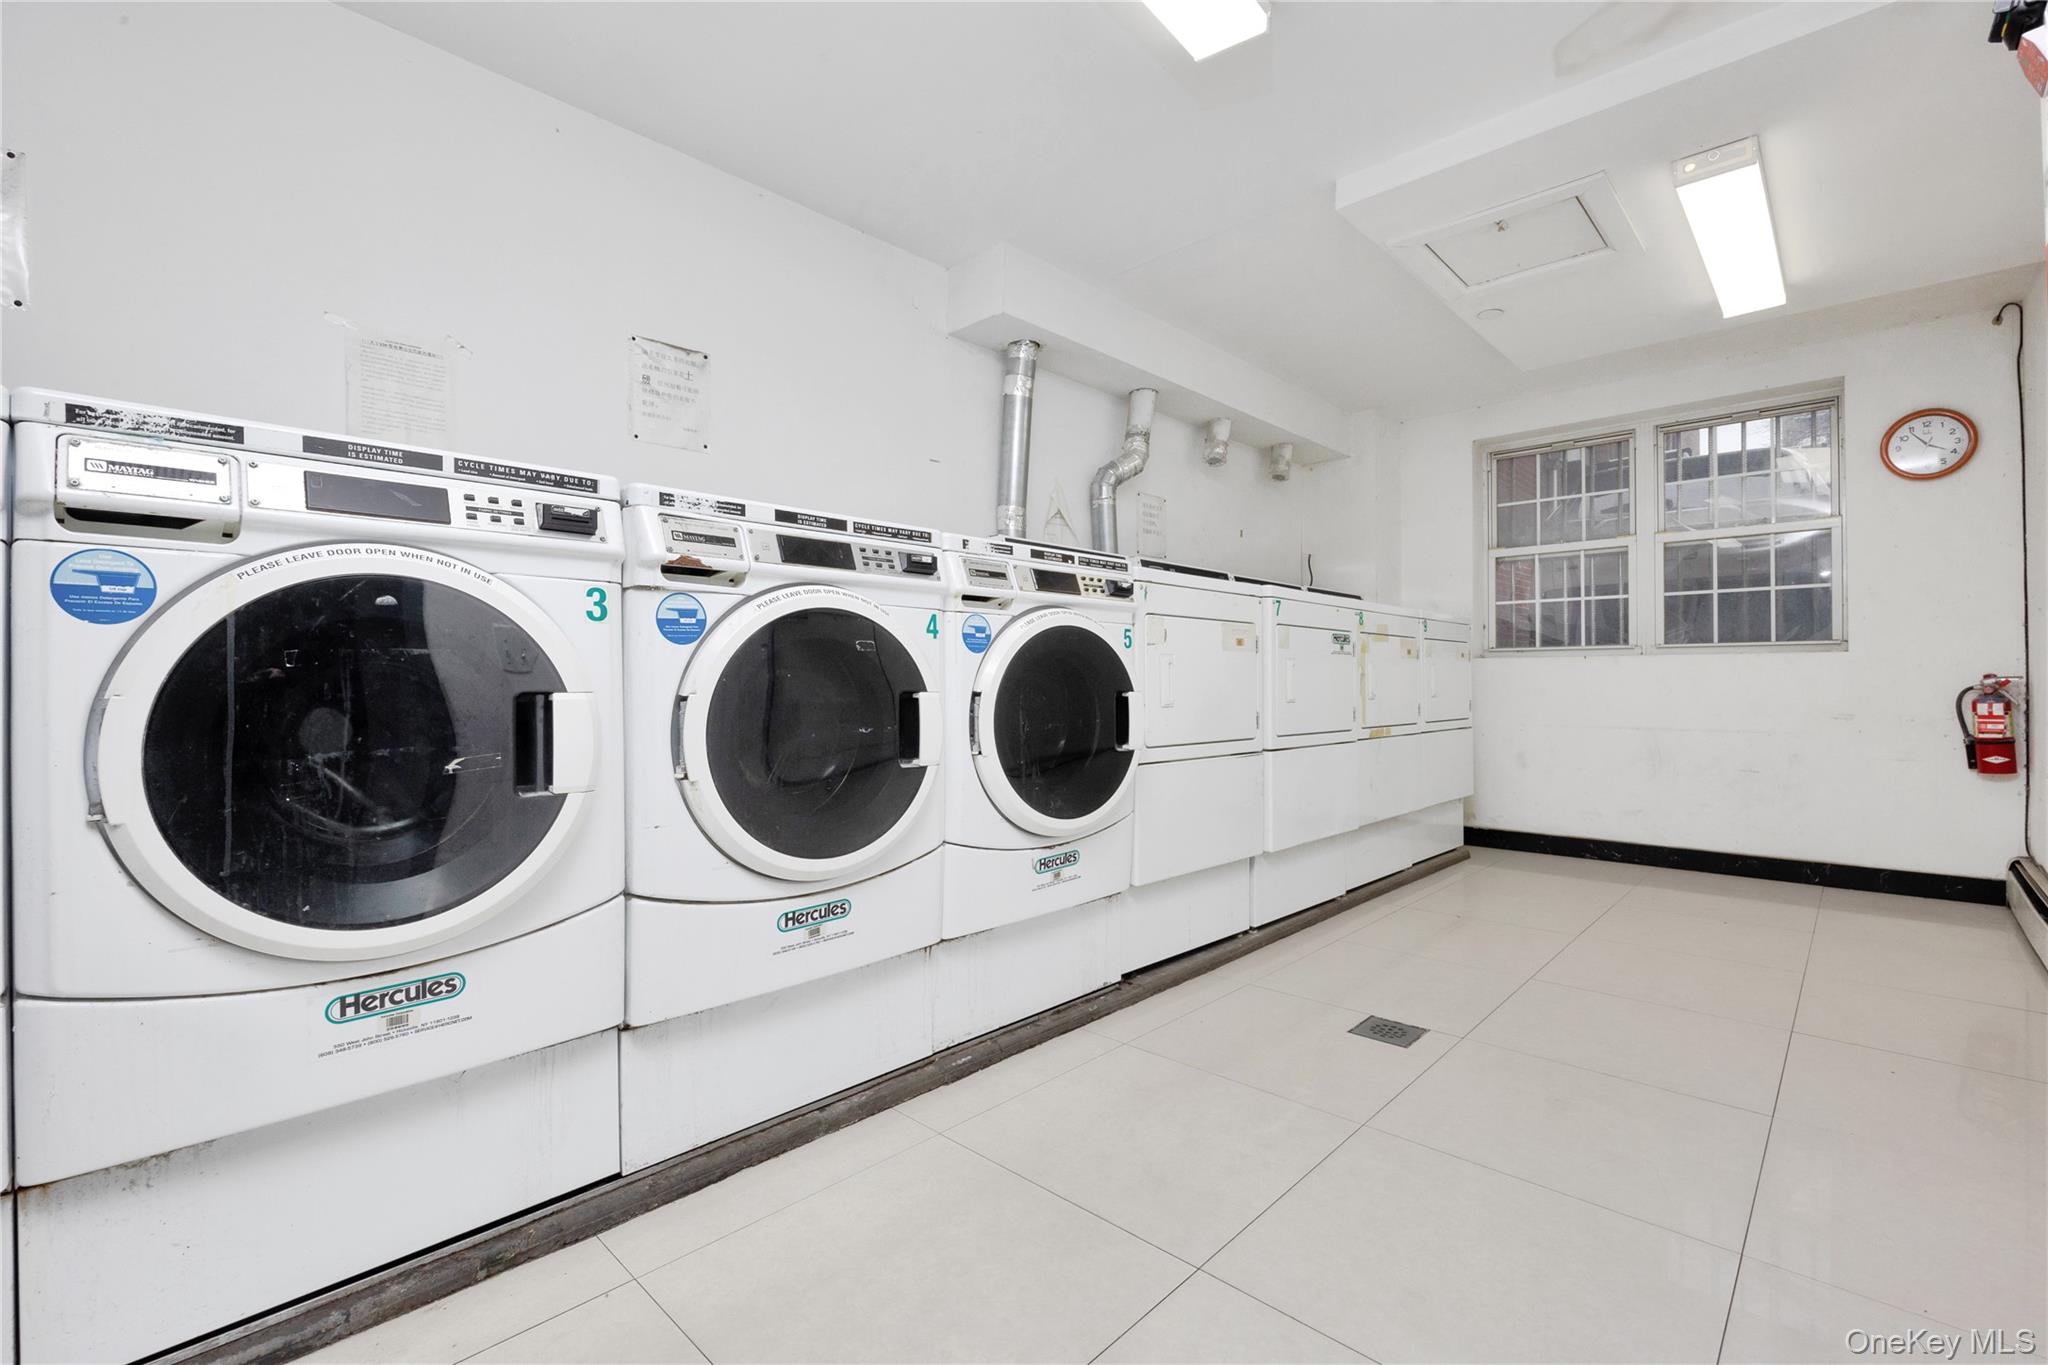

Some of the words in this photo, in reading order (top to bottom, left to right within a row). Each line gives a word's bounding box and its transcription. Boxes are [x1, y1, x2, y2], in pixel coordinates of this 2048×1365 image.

[347, 444, 382, 454] DISPLAY
[384, 449, 403, 457] TIME
[359, 453, 404, 464] ESTIMATED
[107, 464, 154, 476] MAYTAG
[458, 460, 485, 470] CYCLE
[489, 464, 516, 474] TIMES
[520, 470, 537, 478] MAY
[540, 473, 561, 481] VARY
[563, 476, 579, 485] DUE
[582, 479, 595, 487] TO:
[237, 558, 283, 580] PLEASE
[285, 551, 323, 565] LEAVE
[326, 548, 362, 557] DOOR
[365, 548, 397, 556] OPEN
[400, 550, 434, 563] WHEN
[436, 558, 459, 570] NOT
[461, 566, 472, 576] IN
[474, 571, 494, 585] USE
[586, 587, 608, 622] 3
[756, 595, 782, 610] PLEASE
[782, 589, 803, 600] LEAVE
[1276, 600, 1281, 616] 7
[926, 614, 939, 639] 4
[1359, 612, 1364, 625] 8
[1124, 628, 1132, 649] 5
[1040, 852, 1077, 871] Hercules
[784, 902, 847, 928] Hercules
[339, 978, 458, 1018] Hercules
